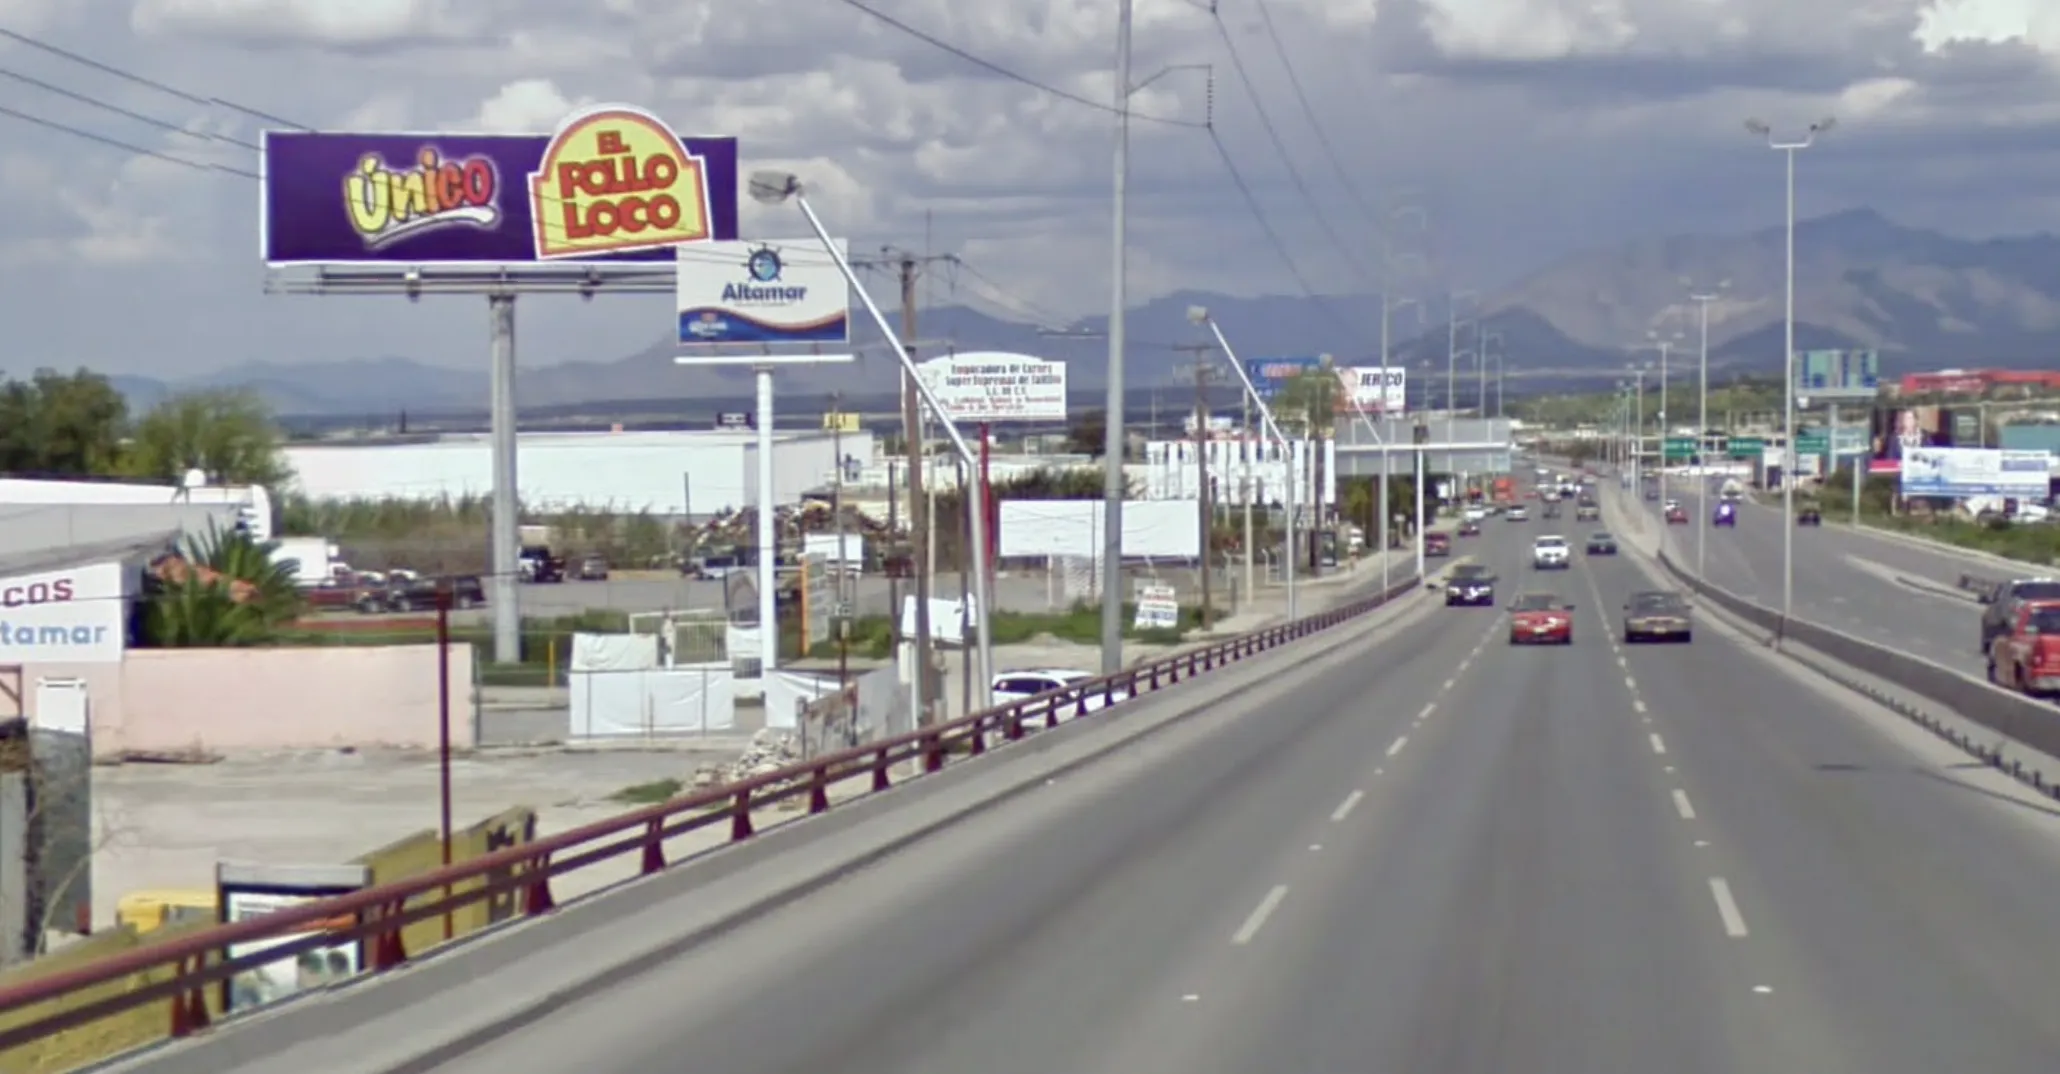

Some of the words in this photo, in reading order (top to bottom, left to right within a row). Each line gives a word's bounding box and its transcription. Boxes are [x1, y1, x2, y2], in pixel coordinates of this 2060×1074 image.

[596, 130, 631, 154] EL
[345, 147, 495, 234] Único
[557, 153, 679, 199] POLLO
[564, 193, 681, 240] LOCO
[721, 281, 807, 302] Altamar
